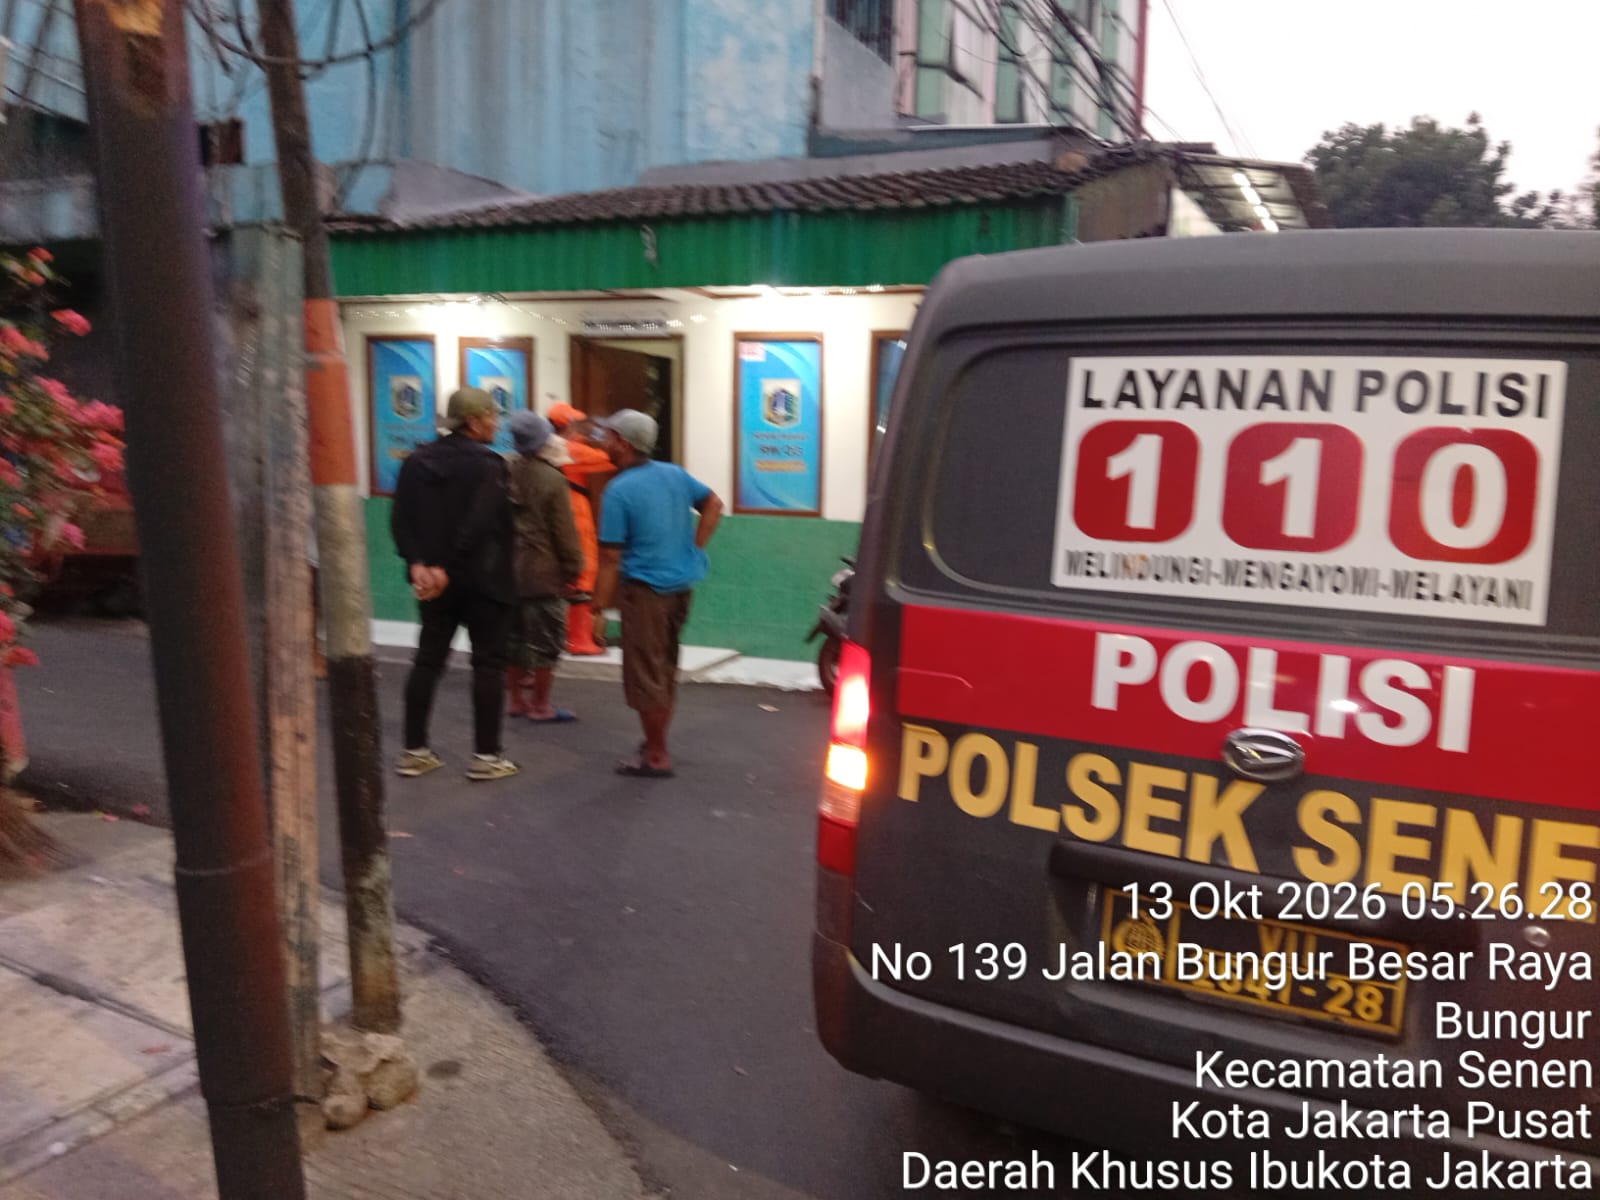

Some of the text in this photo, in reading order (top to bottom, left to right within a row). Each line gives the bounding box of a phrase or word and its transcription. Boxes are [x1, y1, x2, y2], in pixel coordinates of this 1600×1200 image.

[1081, 368, 1552, 419] LAYANAN POLISI
[1091, 631, 1475, 753] POLISI
[897, 722, 1260, 874] POLSEK
